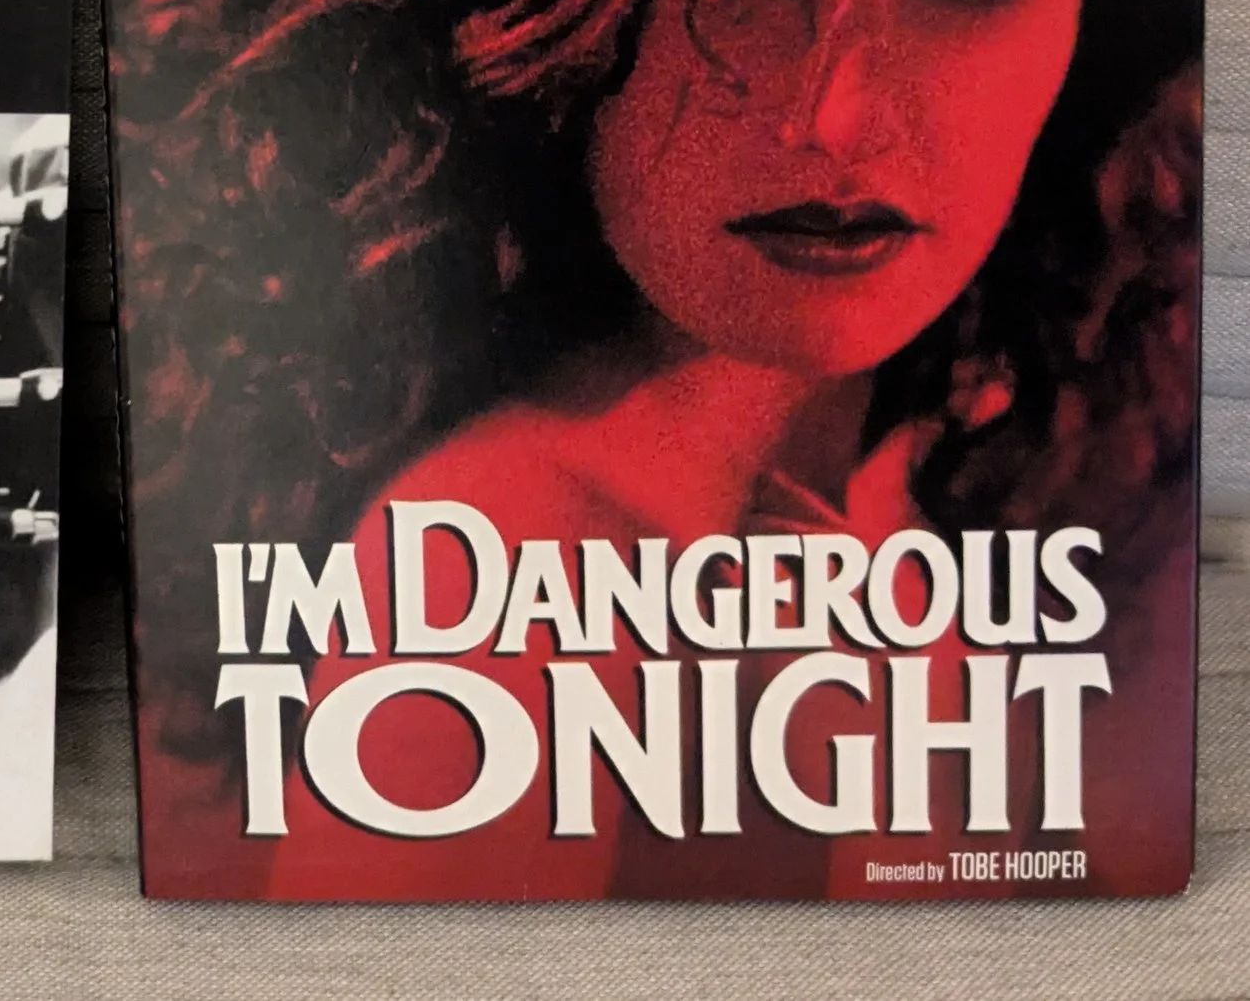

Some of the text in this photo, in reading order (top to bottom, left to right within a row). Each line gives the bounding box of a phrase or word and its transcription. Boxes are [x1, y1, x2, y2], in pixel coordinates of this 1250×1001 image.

[213, 499, 1108, 658] I'M DANGEROUS
[213, 652, 1114, 840] TONIGHT
[865, 850, 1087, 884] Directed by TOBE HOOPER
